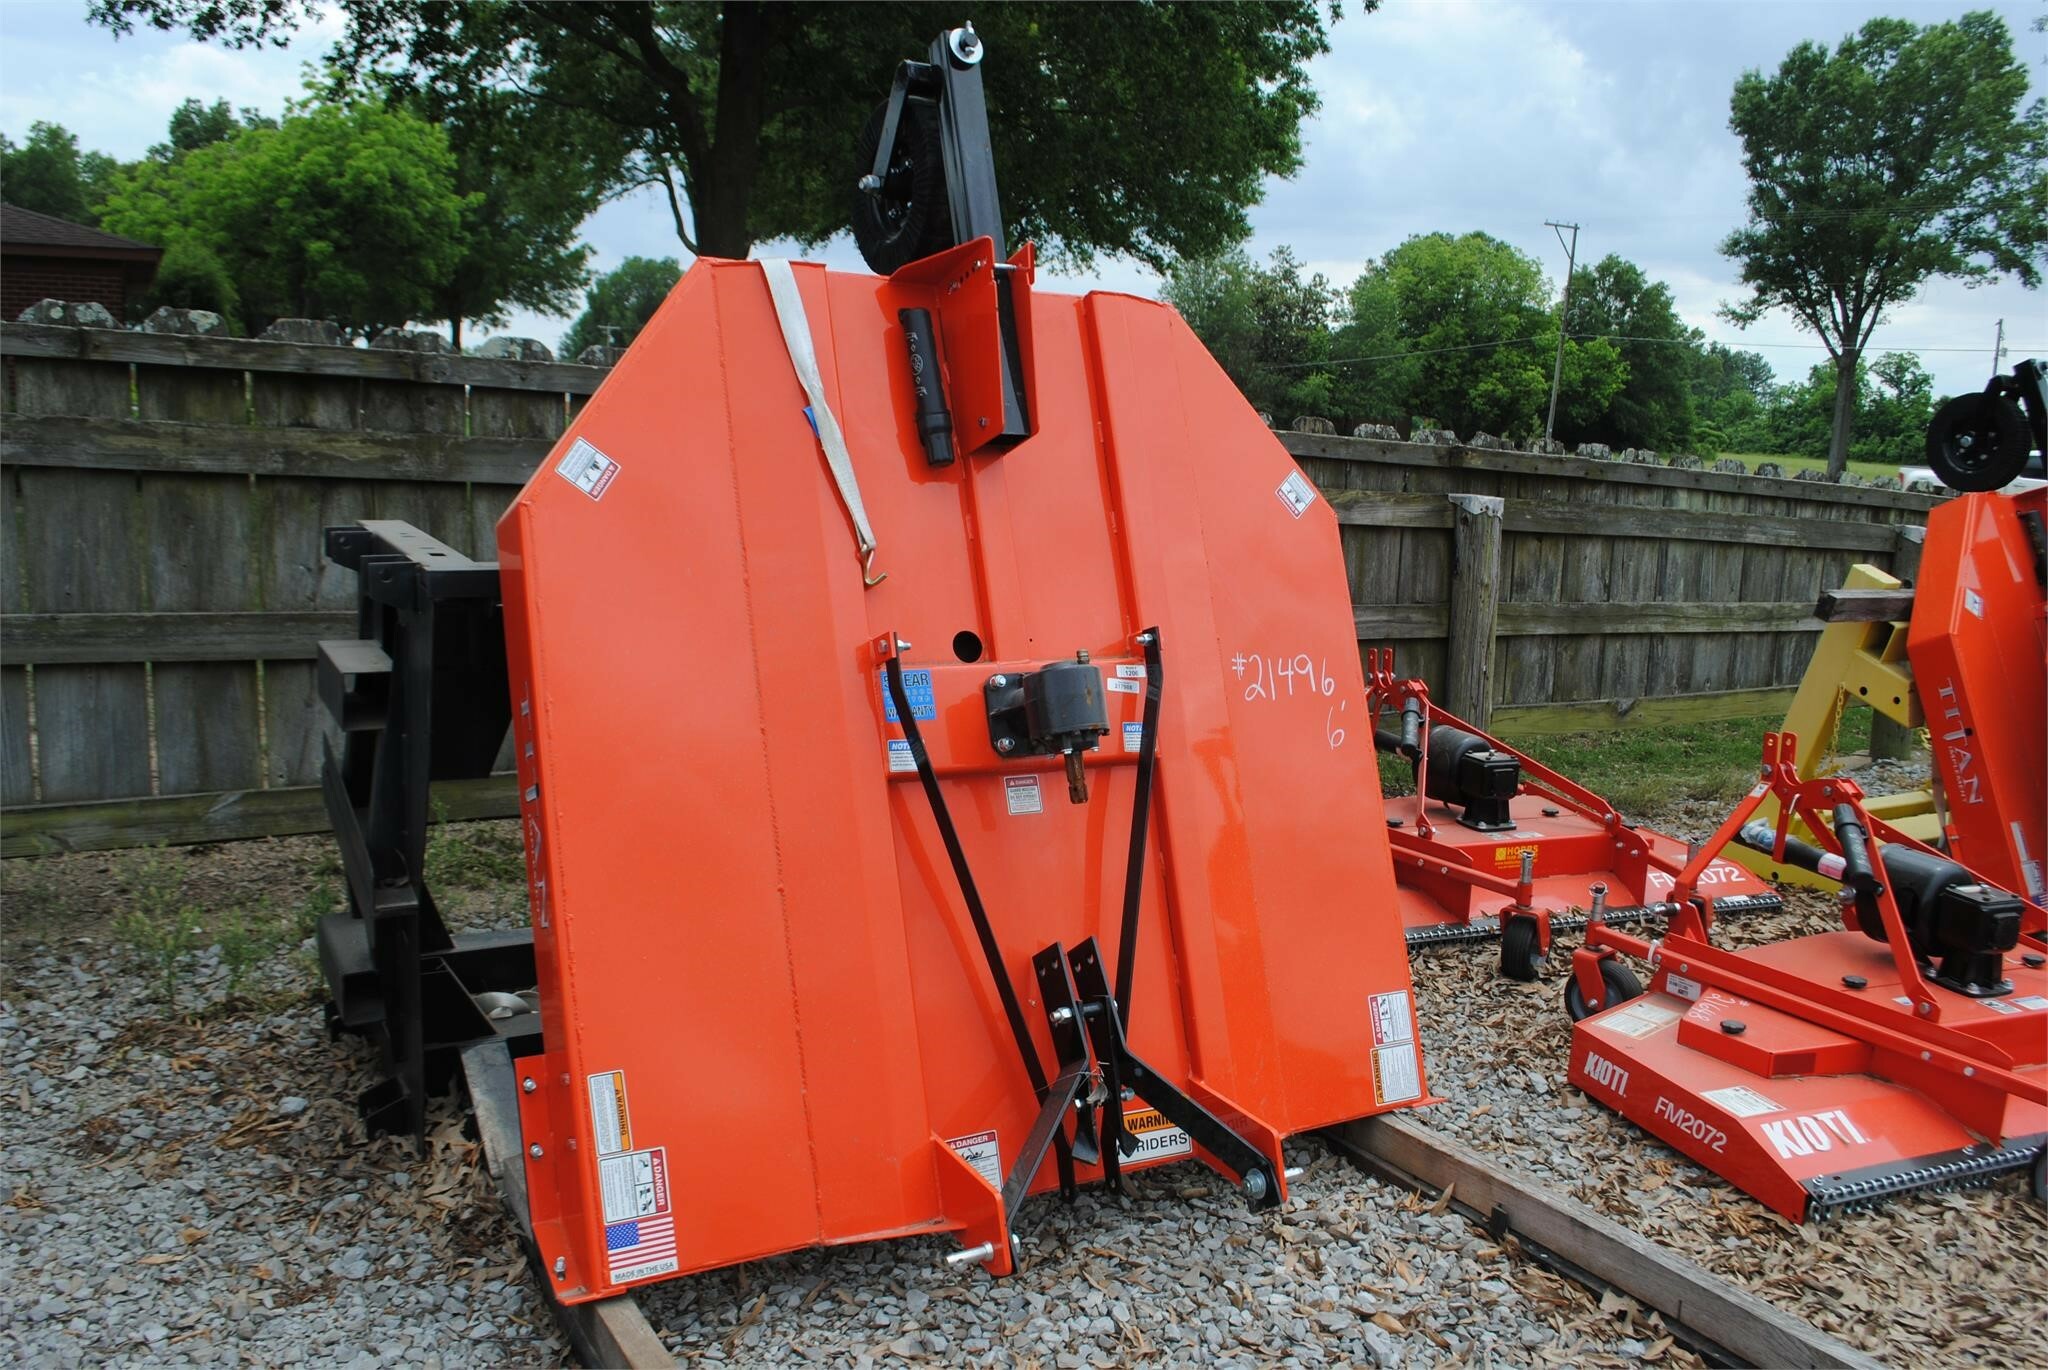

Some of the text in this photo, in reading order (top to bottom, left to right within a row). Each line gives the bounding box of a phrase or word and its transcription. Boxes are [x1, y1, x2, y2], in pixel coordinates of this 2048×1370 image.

[591, 471, 613, 496] DANGER
[903, 673, 929, 687] EAR
[1232, 652, 1335, 701] #21496
[1938, 677, 1983, 804] TITAN
[1584, 1051, 1629, 1096] KIOTI
[615, 1097, 628, 1136] WARNING
[1654, 1096, 1728, 1153] FM2072
[1760, 1110, 1867, 1159] KIOTI
[956, 1135, 988, 1148] DANGER
[1136, 1132, 1188, 1152] RIDERS
[653, 1167, 665, 1207] DANGER
[614, 1270, 635, 1281] MADE
[645, 1265, 659, 1274] THE
[660, 1261, 674, 1271] USA
